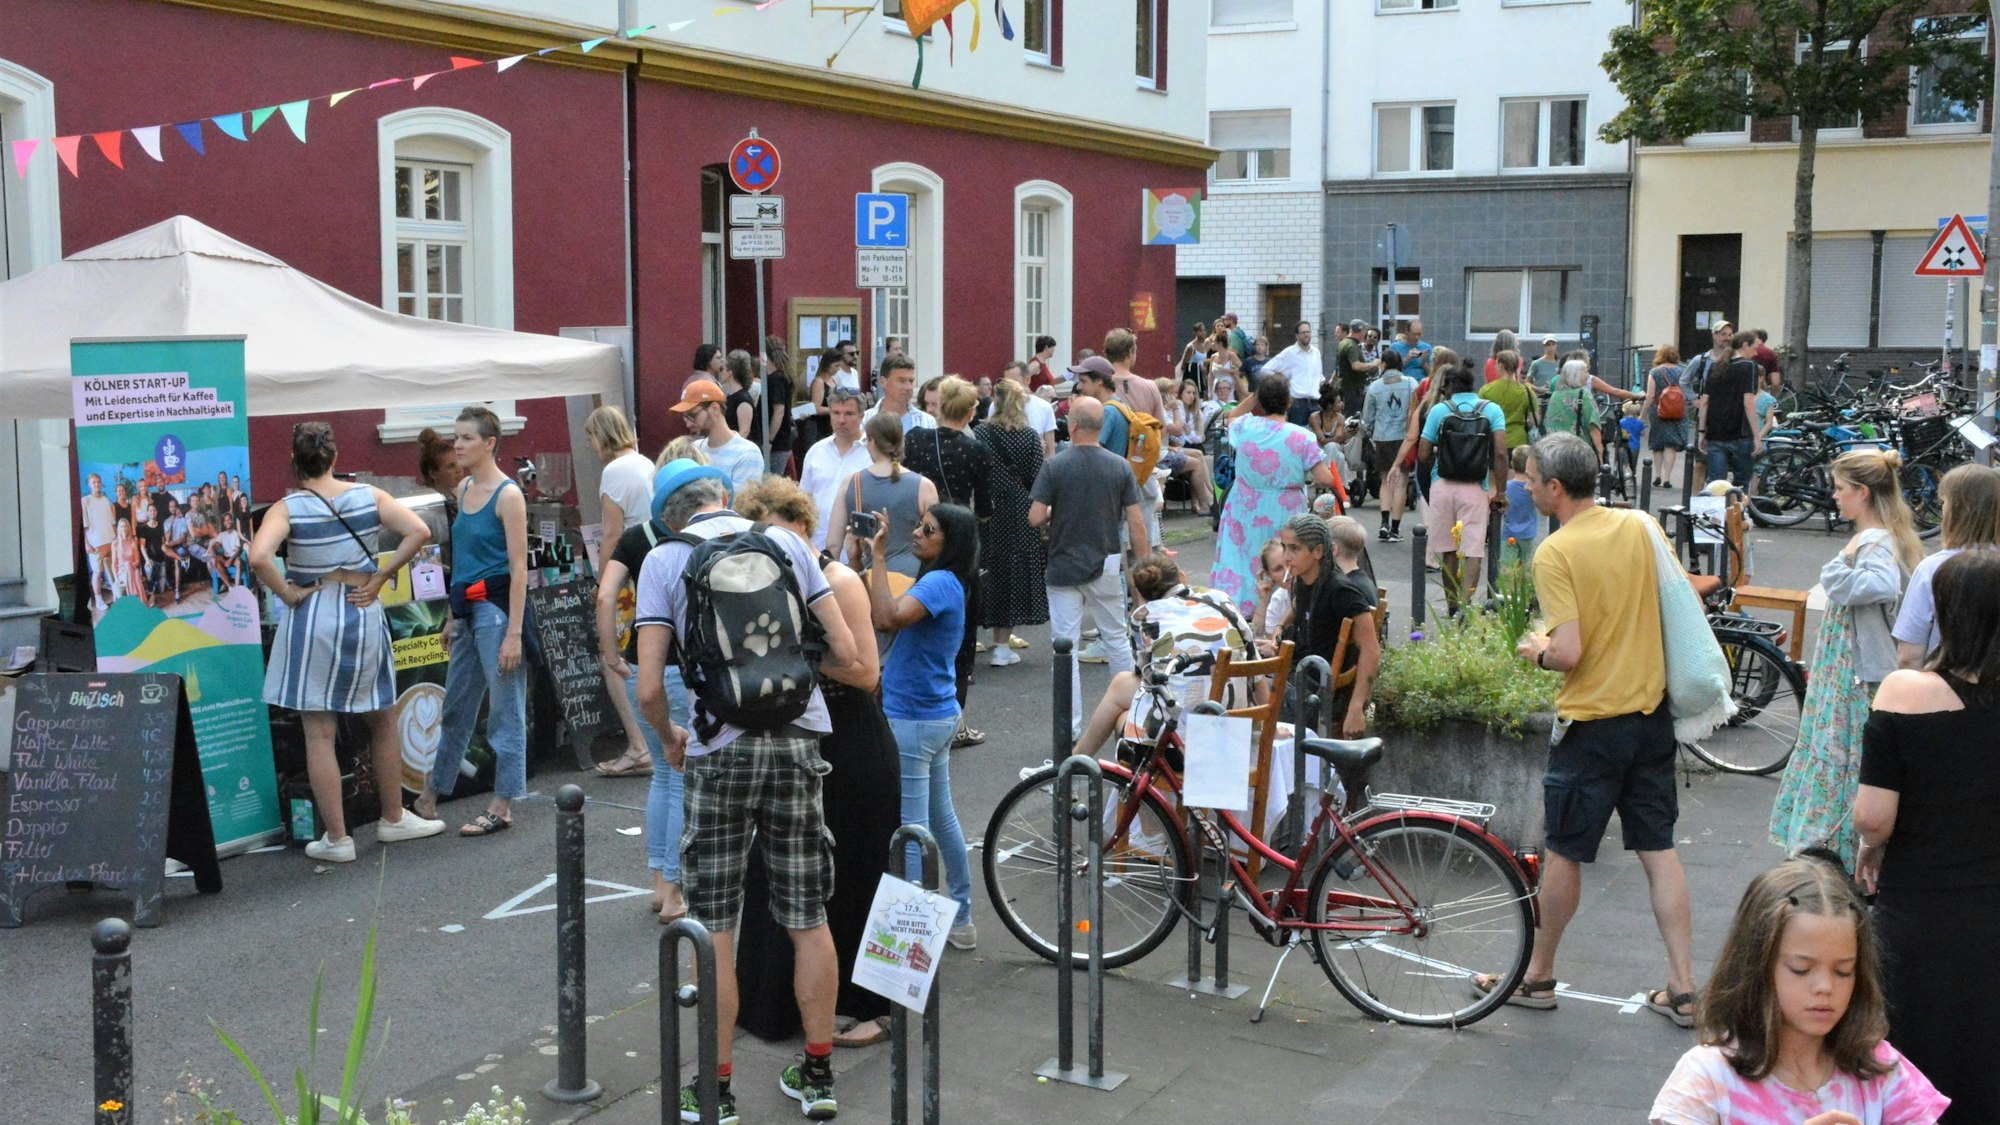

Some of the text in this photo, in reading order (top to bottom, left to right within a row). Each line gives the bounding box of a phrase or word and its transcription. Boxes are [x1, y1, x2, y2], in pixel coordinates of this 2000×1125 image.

[868, 200, 895, 240] P
[861, 265, 880, 273] Mo-Fr
[861, 274, 869, 282] Sa
[84, 377, 186, 392] KÖLNER START-UP
[85, 391, 214, 407] Mit Leidenschaft für Kaffee
[86, 403, 232, 422] und Expertise in Nachhaltigkeit
[392, 637, 442, 654] Specialty Co
[394, 657, 407, 667] mit
[69, 690, 124, 709] BioZisch
[15, 711, 106, 735] Cappuccino
[13, 752, 45, 769] Flat
[55, 754, 100, 770] White
[14, 771, 73, 792] Vanilla
[10, 793, 82, 816] Espresso
[5, 817, 69, 839] Doppio
[5, 840, 54, 859] Filter
[904, 904, 922, 913] 17.9.
[891, 925, 907, 934] NICHT
[911, 921, 927, 929] BITTE
